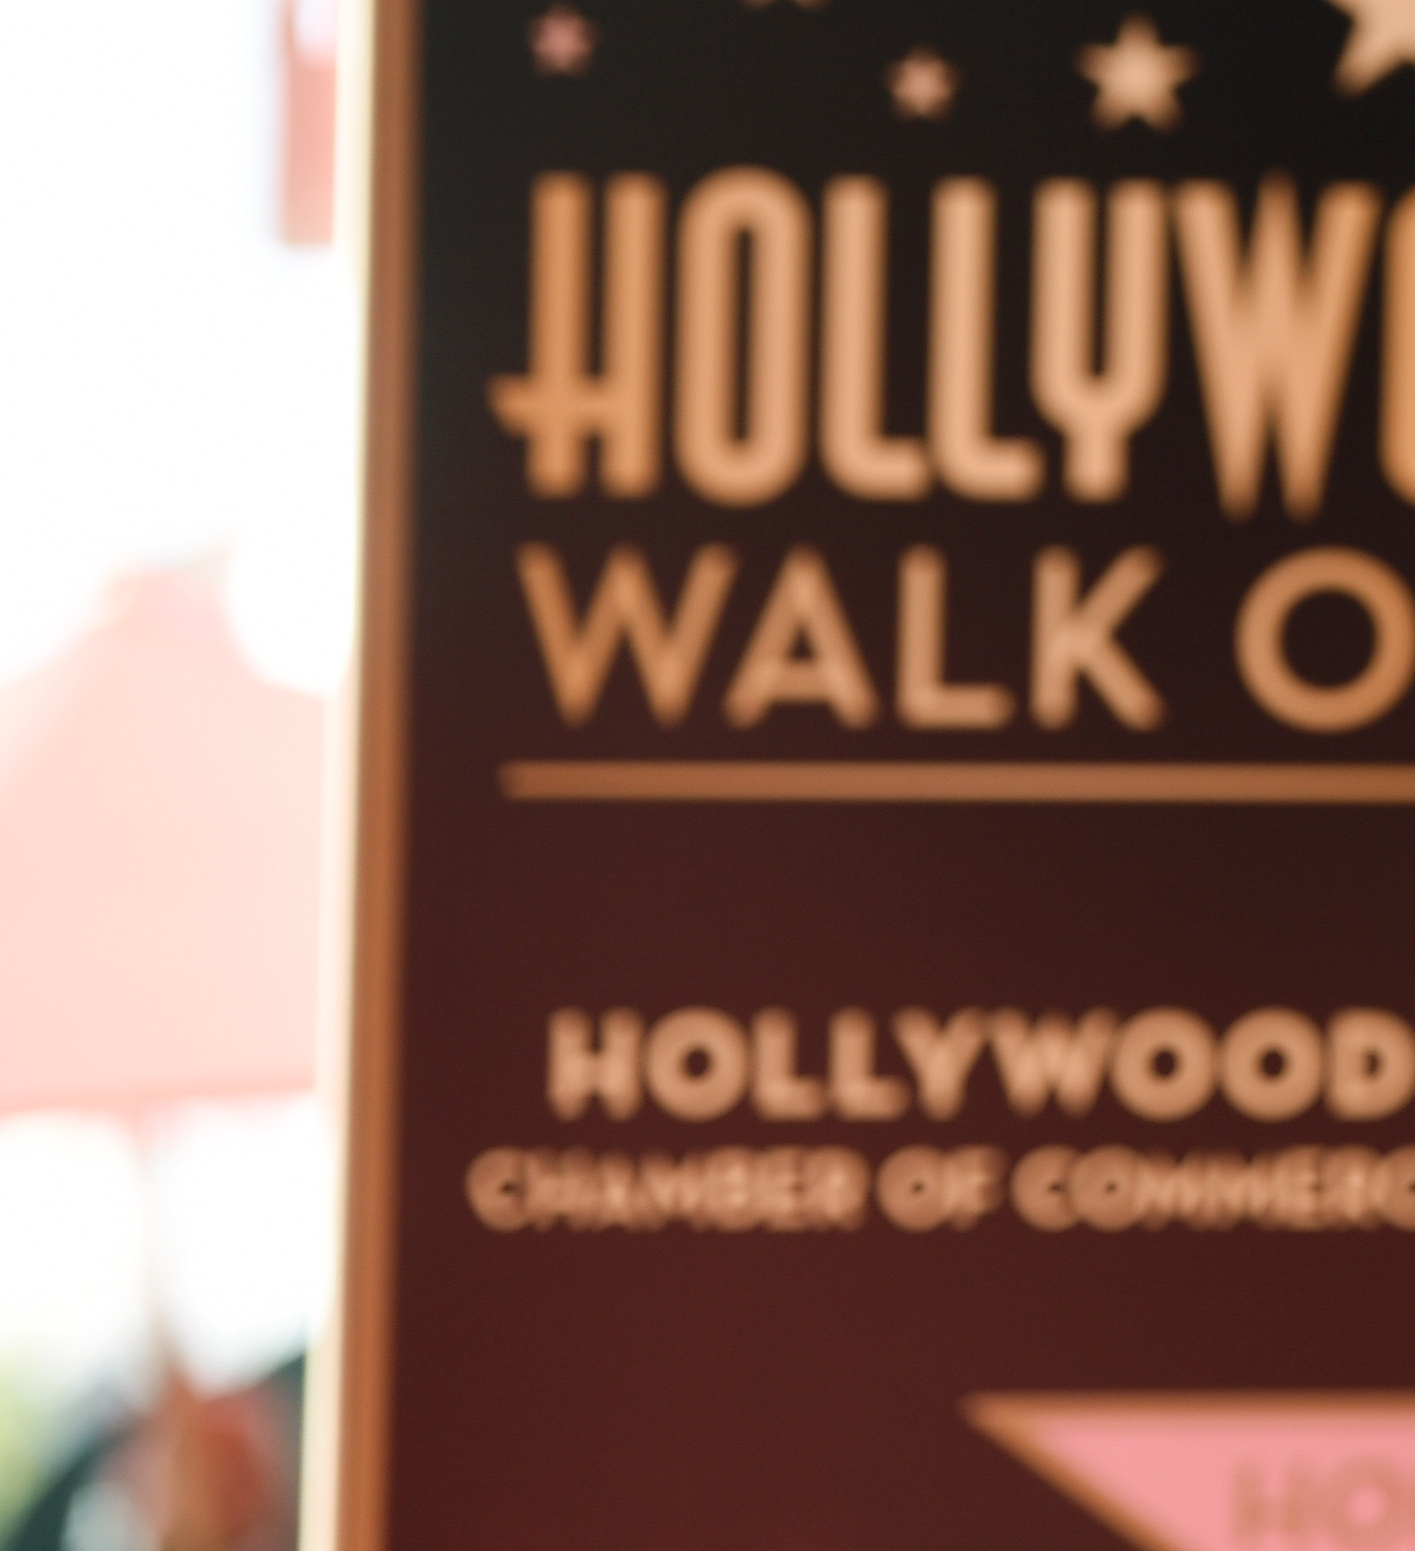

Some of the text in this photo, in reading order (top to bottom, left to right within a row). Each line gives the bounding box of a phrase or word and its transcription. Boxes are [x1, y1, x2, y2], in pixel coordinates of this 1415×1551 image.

[515, 541, 1166, 732] WALK
[464, 1143, 868, 1233] CHAMBER
[876, 1143, 1000, 1233] OF
